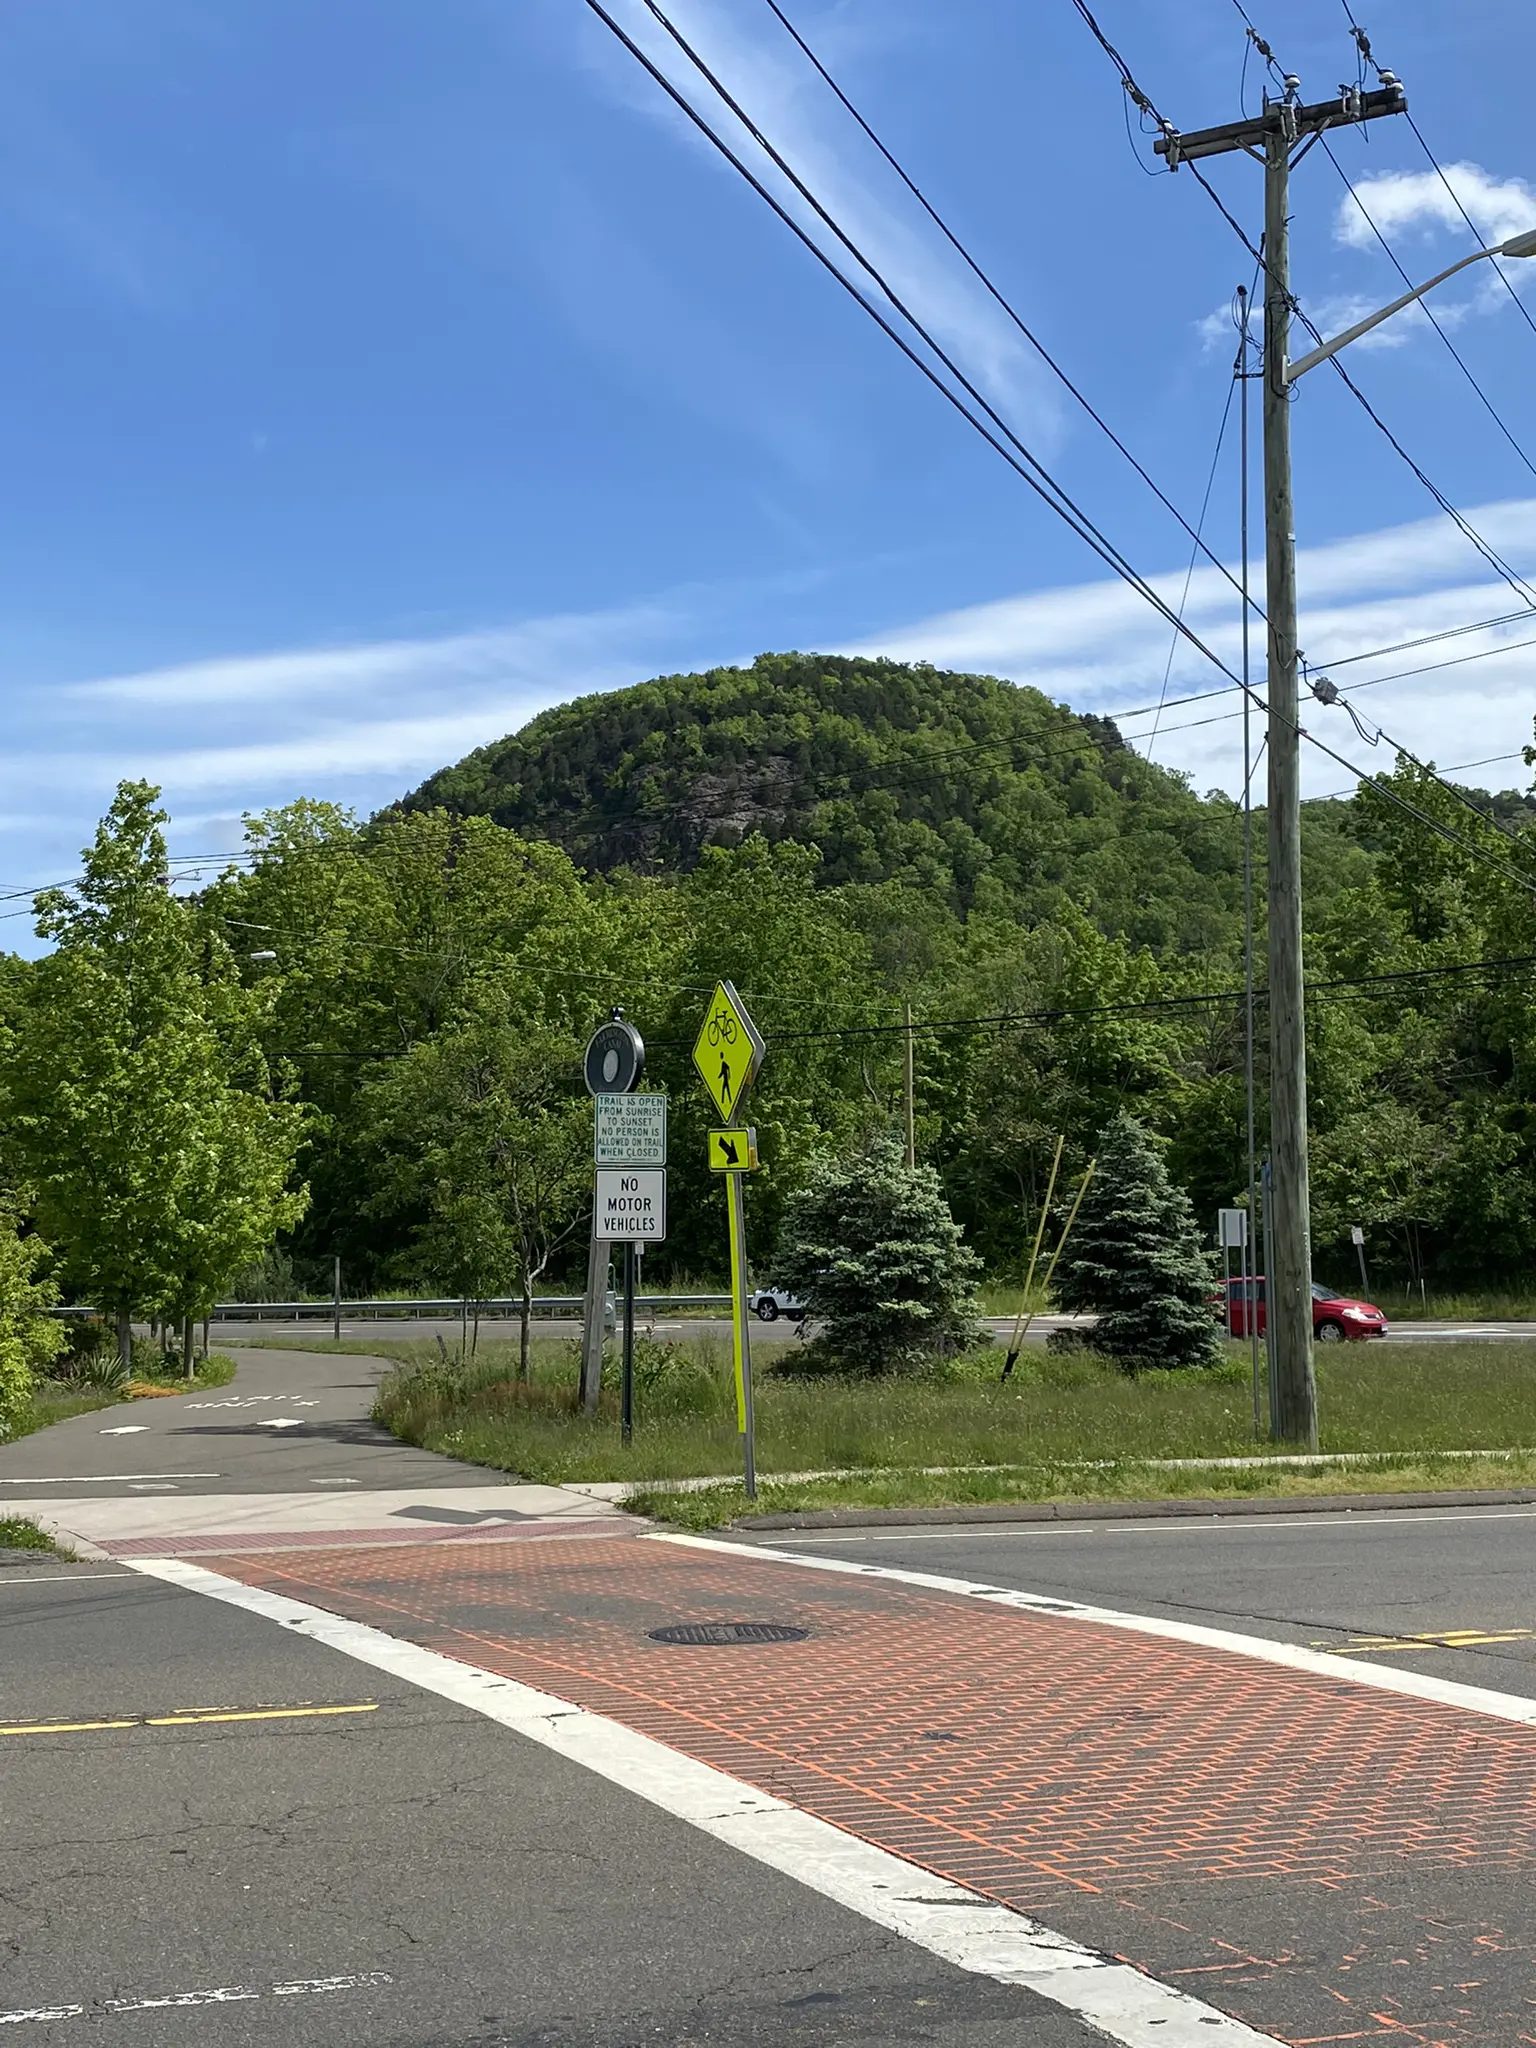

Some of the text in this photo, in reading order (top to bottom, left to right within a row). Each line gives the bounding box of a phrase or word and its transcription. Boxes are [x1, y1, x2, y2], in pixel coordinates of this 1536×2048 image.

[599, 1097, 663, 1107] TRAIL IS OPEN
[599, 1106, 662, 1116] FROM SUNRISE
[607, 1117, 652, 1126] TO SUNSET
[601, 1127, 660, 1137] NO PERSON IS
[598, 1137, 663, 1147] ALLOWED ON TRAIL
[600, 1147, 623, 1157] WHEN
[620, 1178, 639, 1192] NO
[607, 1197, 652, 1211] MOTOR
[604, 1217, 655, 1231] VEHICLES
